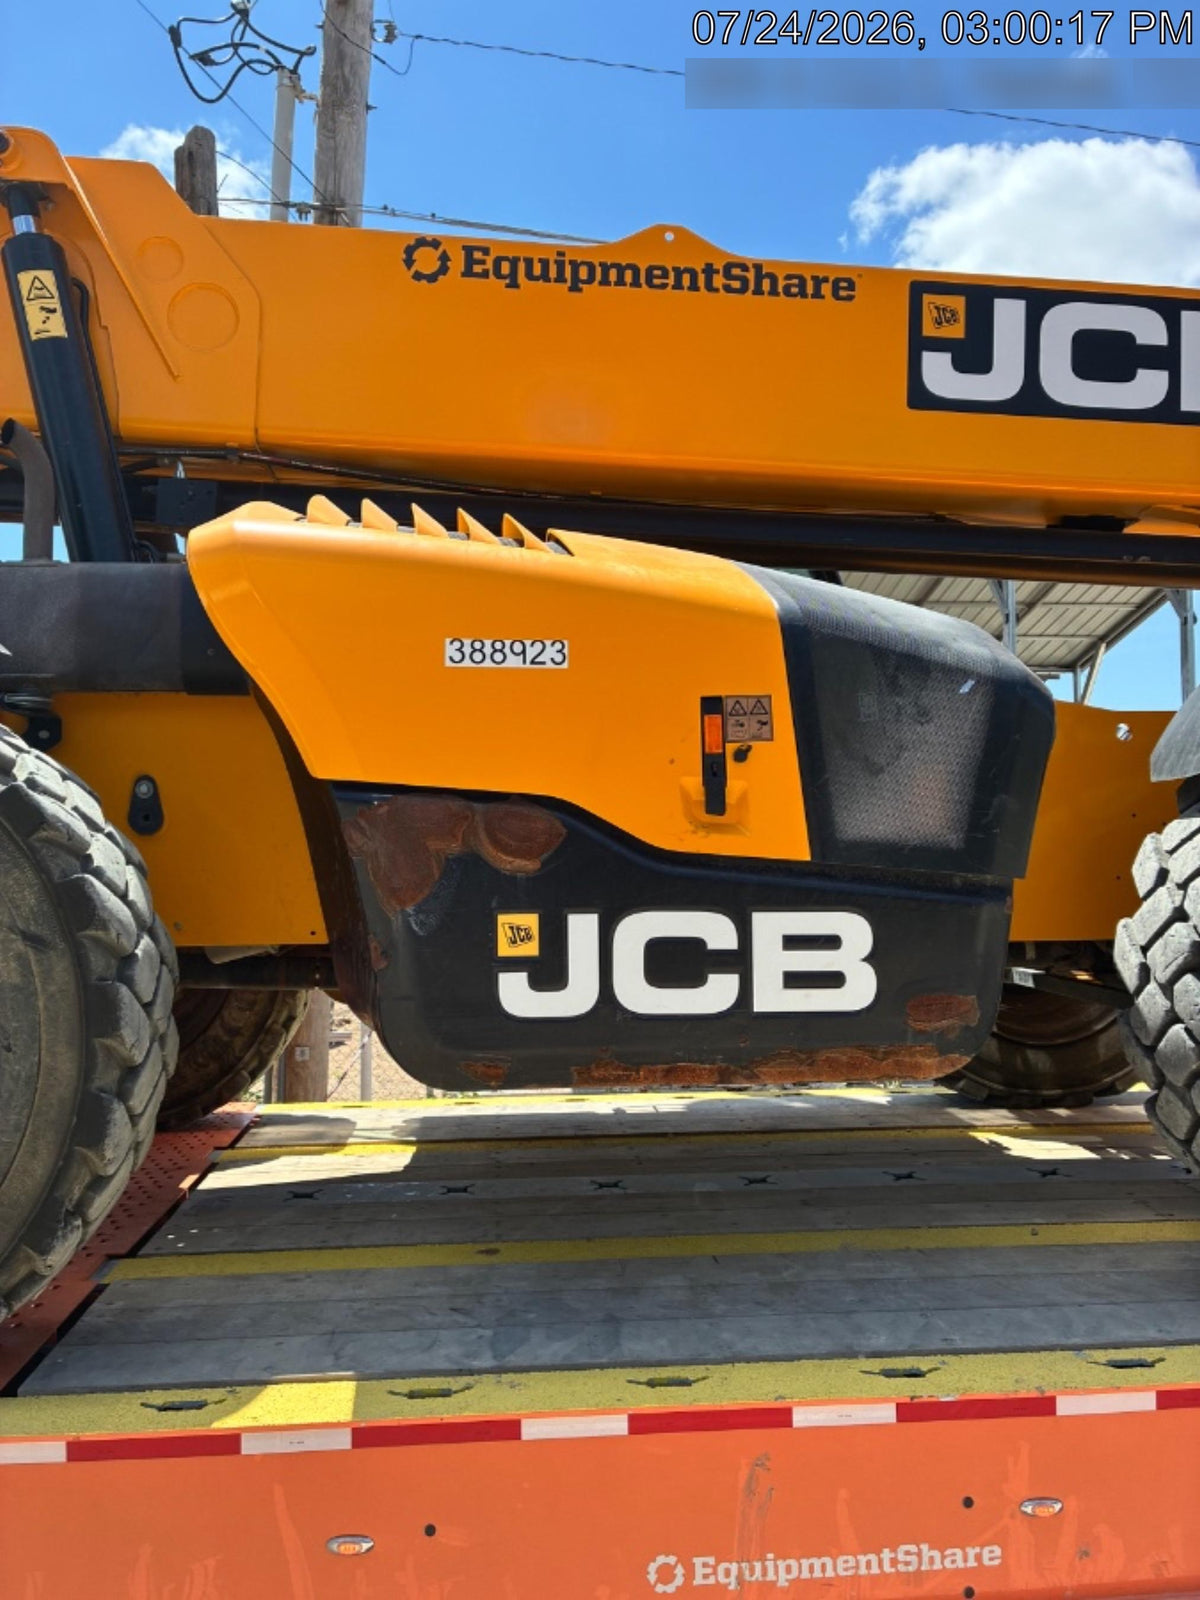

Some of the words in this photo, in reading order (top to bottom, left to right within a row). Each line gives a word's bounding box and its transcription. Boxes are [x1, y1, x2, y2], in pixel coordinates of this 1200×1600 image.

[461, 245, 857, 302] EquipmentShare
[921, 298, 1200, 412] JC
[448, 638, 567, 666] 388923
[507, 926, 533, 945] JCB
[498, 911, 878, 1018] JCB
[692, 1543, 1002, 1590] EquipmentShare
